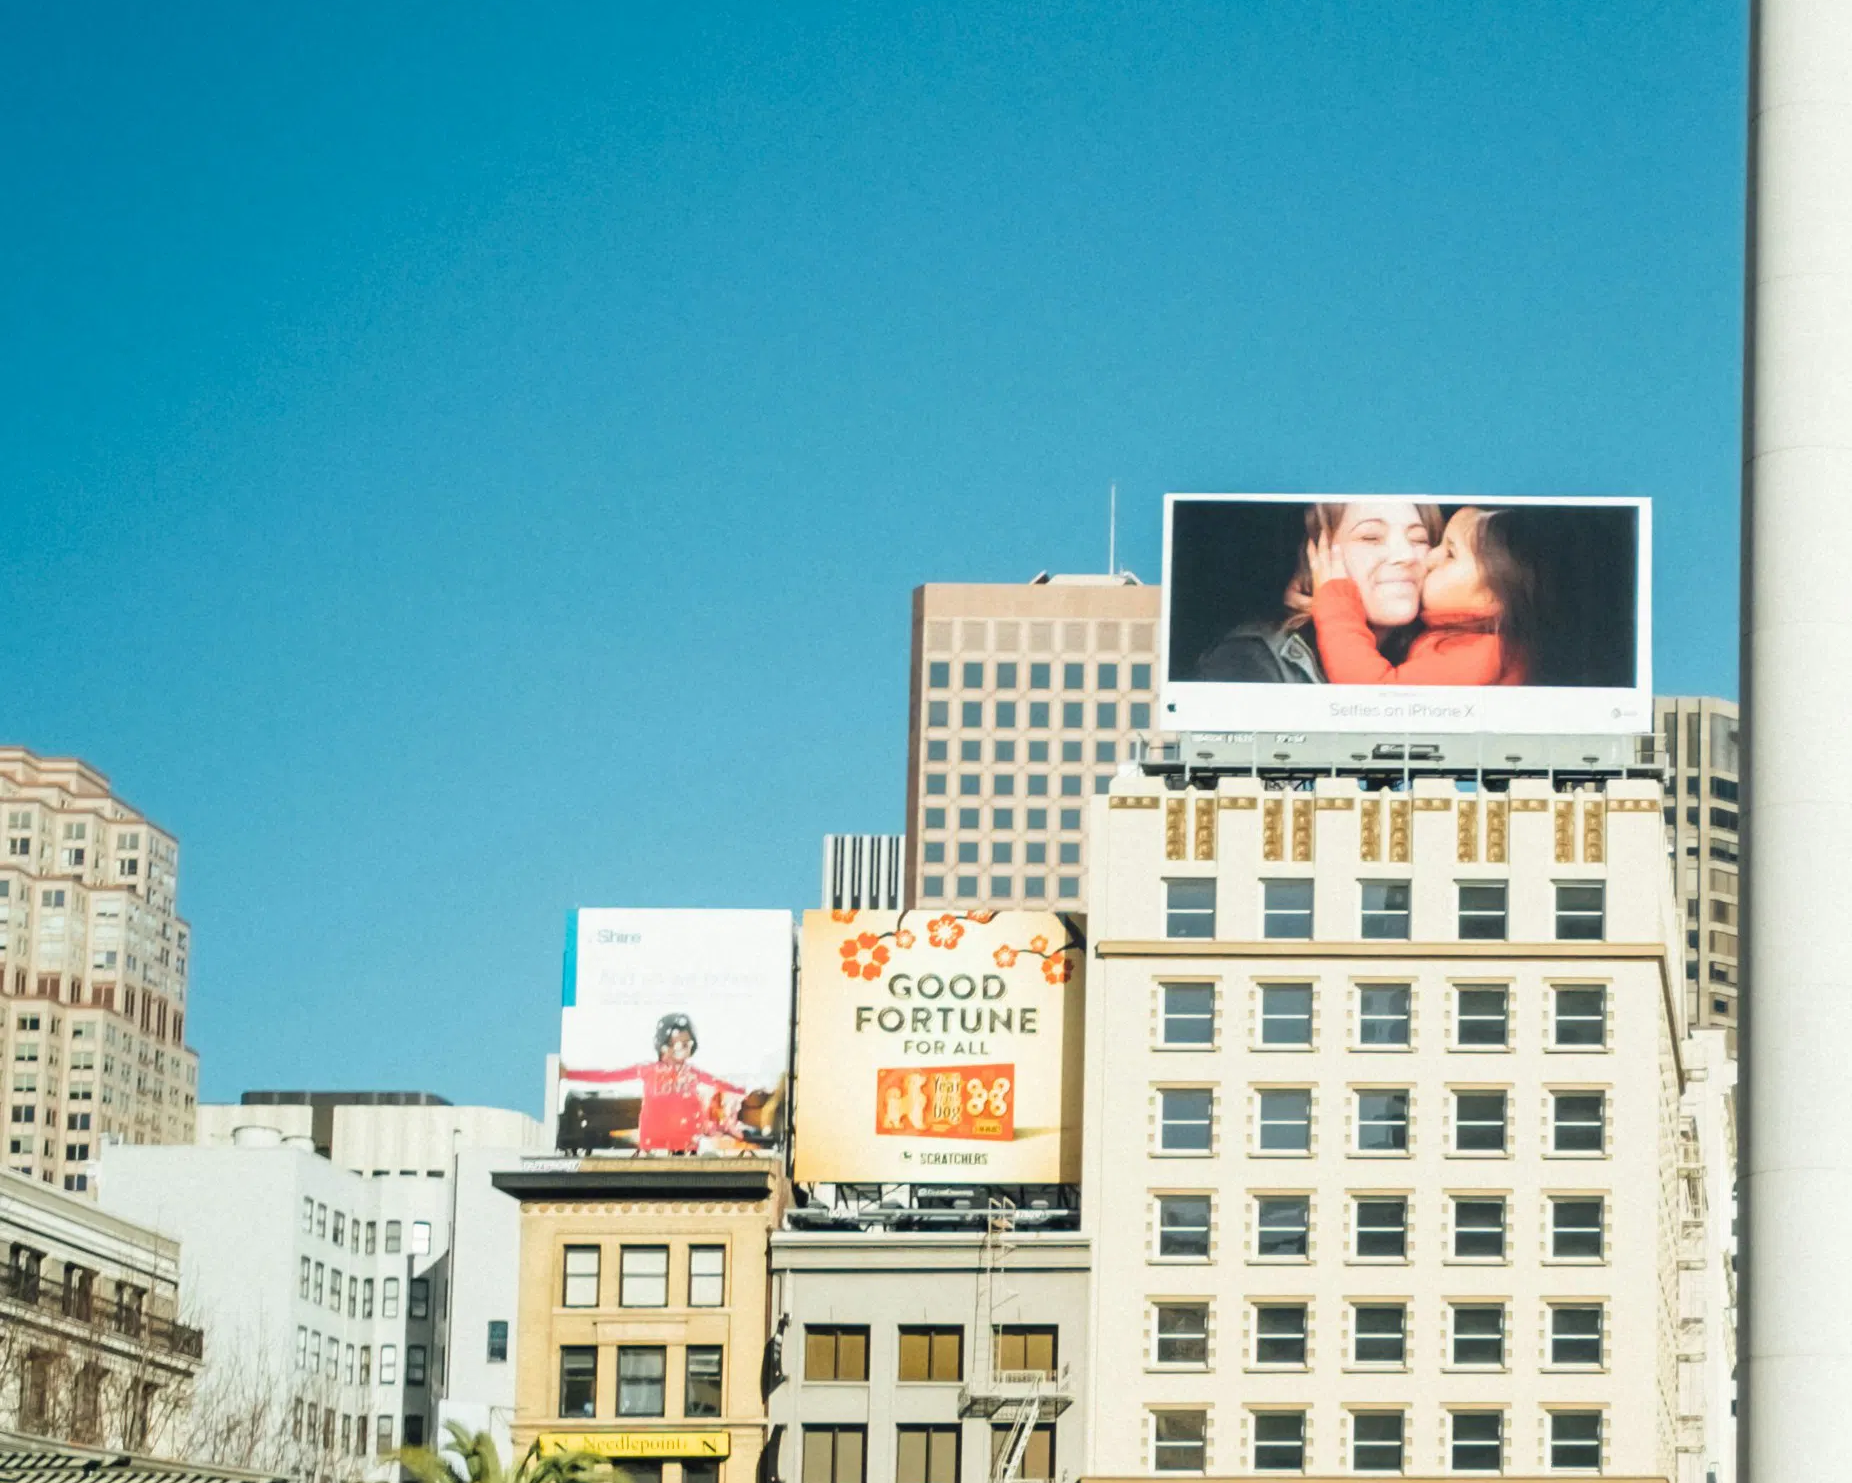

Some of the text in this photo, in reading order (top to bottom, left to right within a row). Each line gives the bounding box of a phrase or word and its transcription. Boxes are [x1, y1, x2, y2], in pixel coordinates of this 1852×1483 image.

[1329, 702, 1476, 717] Selfies on iPhone X
[888, 973, 1007, 1000] GOOD
[855, 1005, 1038, 1034] FORTUNE
[904, 1040, 990, 1055] FOR ALL
[934, 1075, 959, 1094] Year
[933, 1103, 961, 1123] Dog
[920, 1153, 989, 1166] SCRATCHERS
[702, 1437, 717, 1454] N
